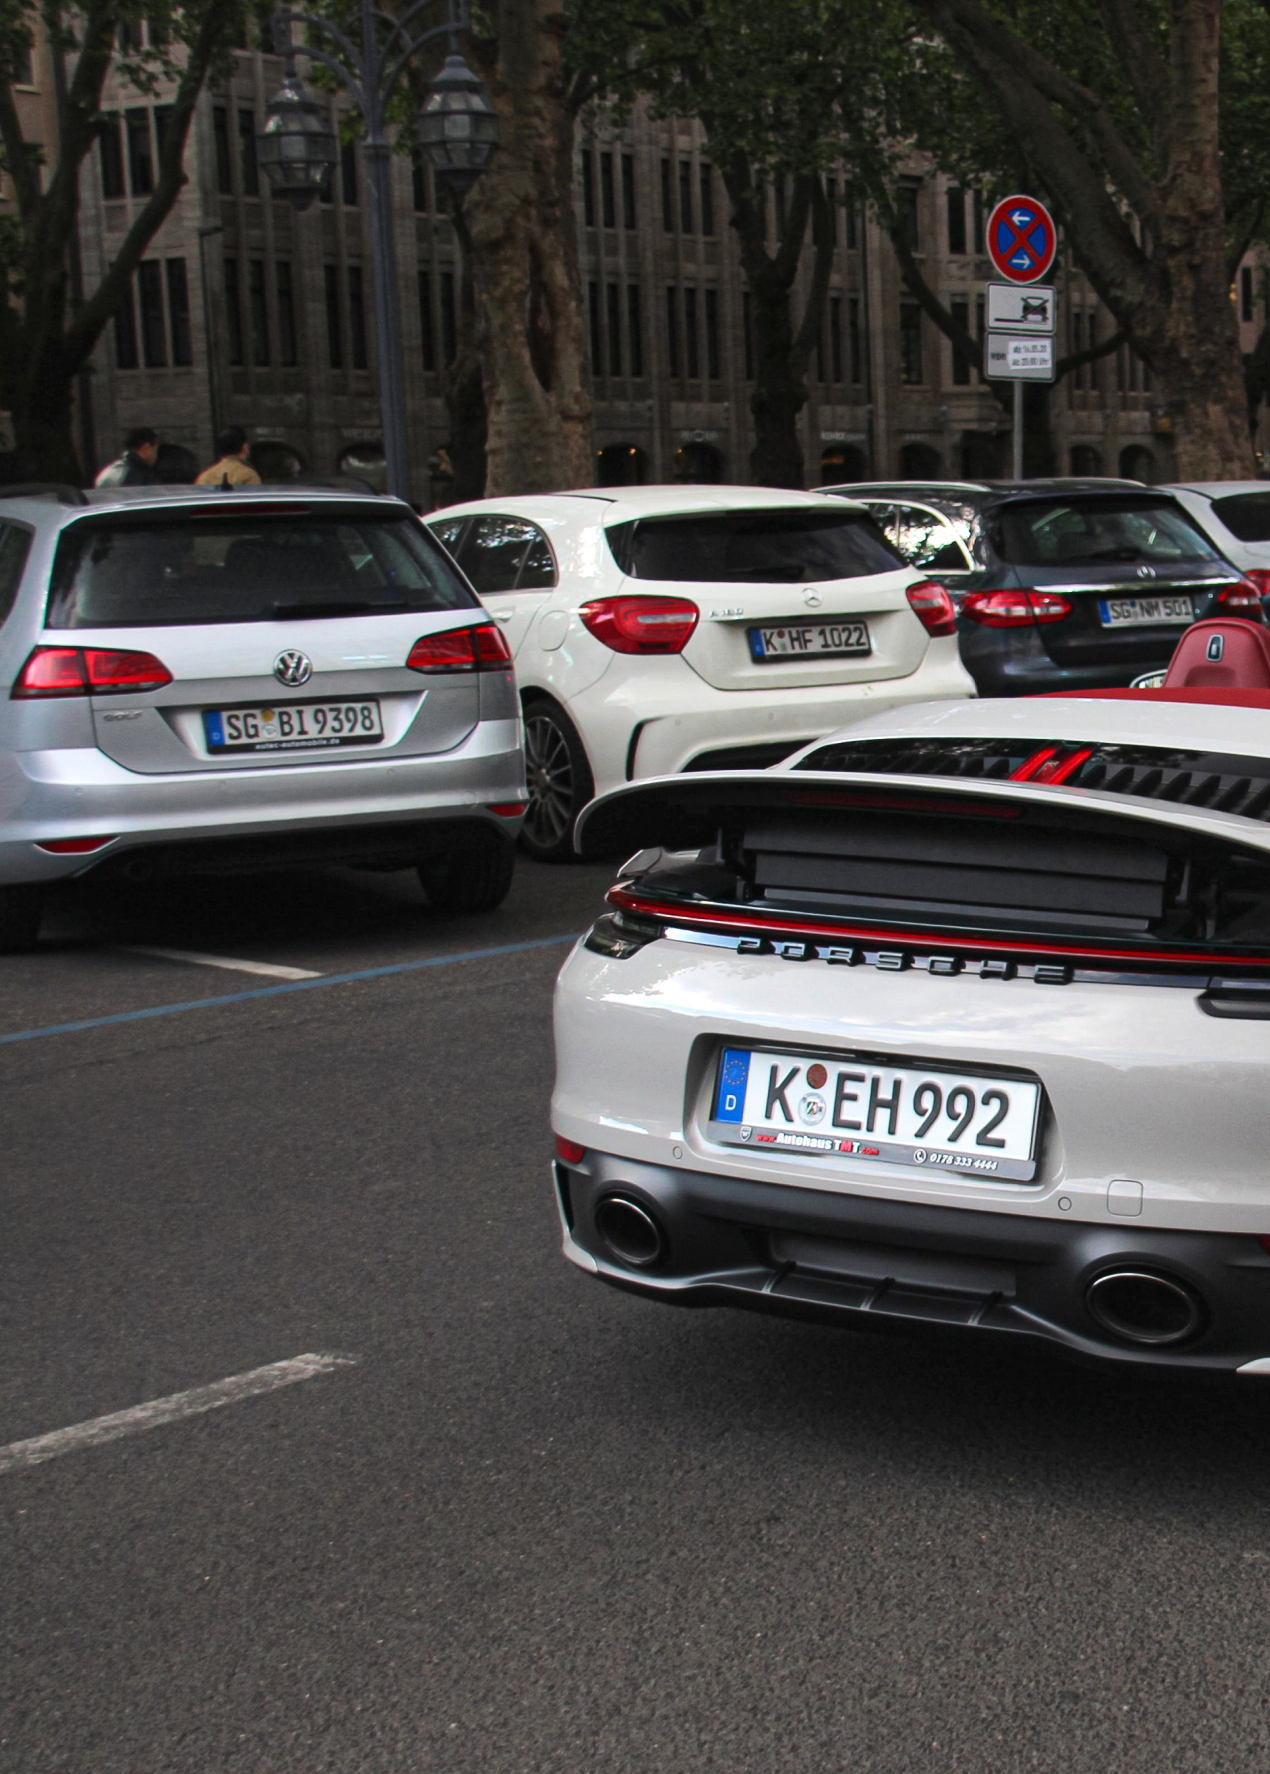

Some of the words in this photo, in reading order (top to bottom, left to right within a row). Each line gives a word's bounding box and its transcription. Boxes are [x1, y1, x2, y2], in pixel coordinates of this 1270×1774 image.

[1110, 601, 1132, 620] SG
[763, 631, 779, 653] K
[788, 629, 814, 651] HF
[818, 626, 867, 649] 1022
[228, 713, 260, 741] SG
[279, 709, 309, 738] BI
[315, 705, 375, 736] 9398
[736, 936, 1074, 985] PORSCHE
[724, 1094, 737, 1112] D
[764, 1063, 801, 1123] K
[831, 1070, 903, 1136] EH
[912, 1081, 1012, 1149] 992
[929, 1152, 953, 1166] 0178
[954, 1155, 973, 1168] 333
[973, 1157, 998, 1171] 4444
